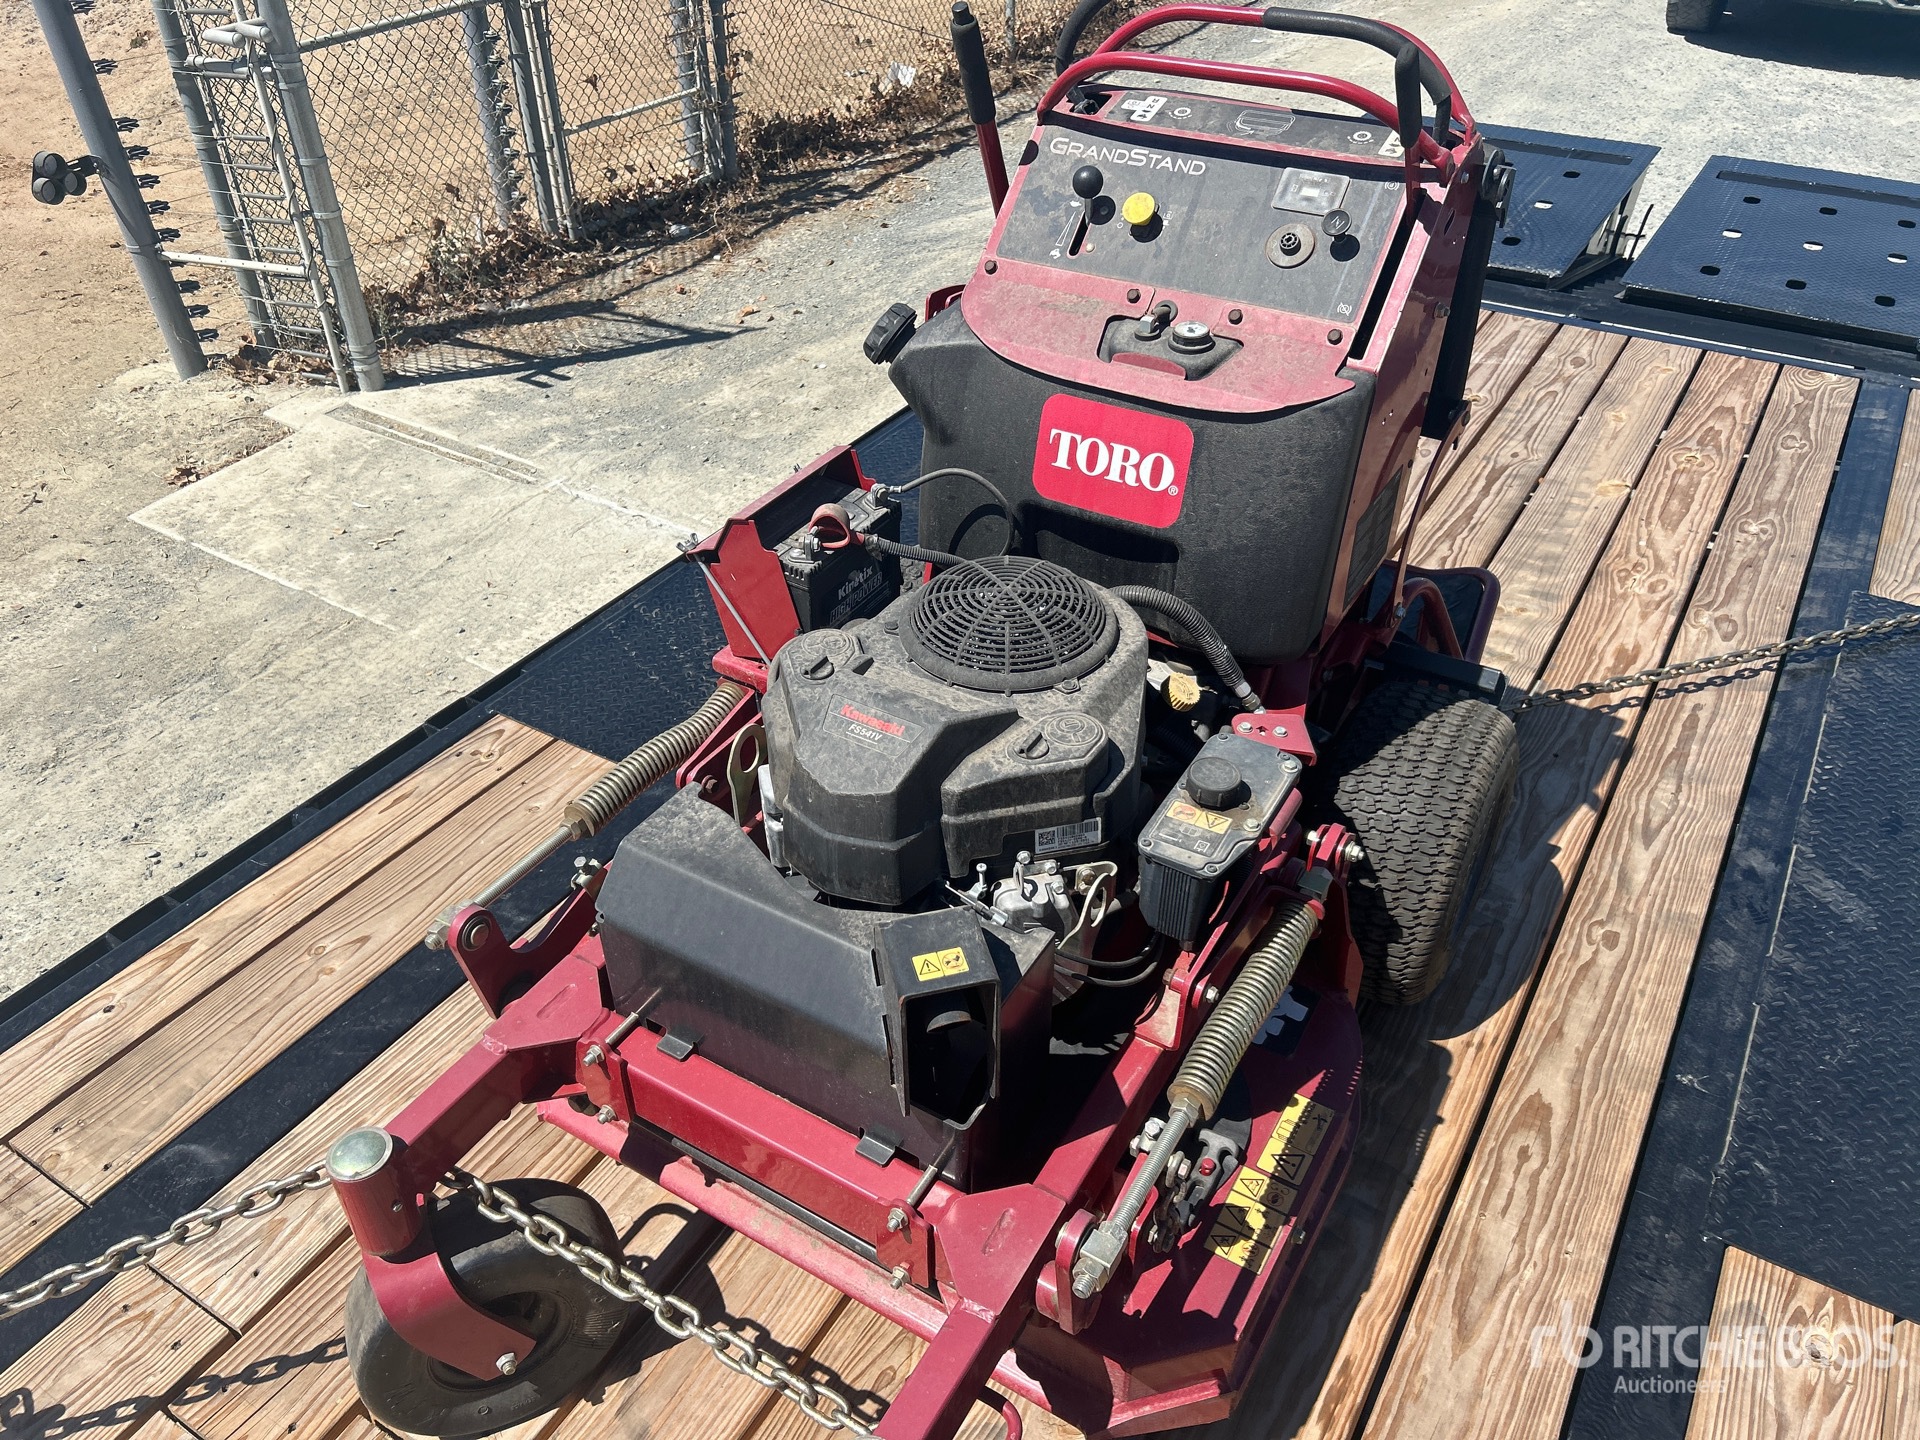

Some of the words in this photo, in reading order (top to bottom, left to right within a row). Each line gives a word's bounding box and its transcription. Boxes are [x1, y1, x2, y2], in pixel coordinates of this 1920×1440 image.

[829, 595, 853, 626] HIGH
[851, 571, 883, 608] POWER
[838, 565, 873, 600] Kinetix
[840, 703, 906, 736] Kawasaki
[848, 723, 883, 741] FS541V
